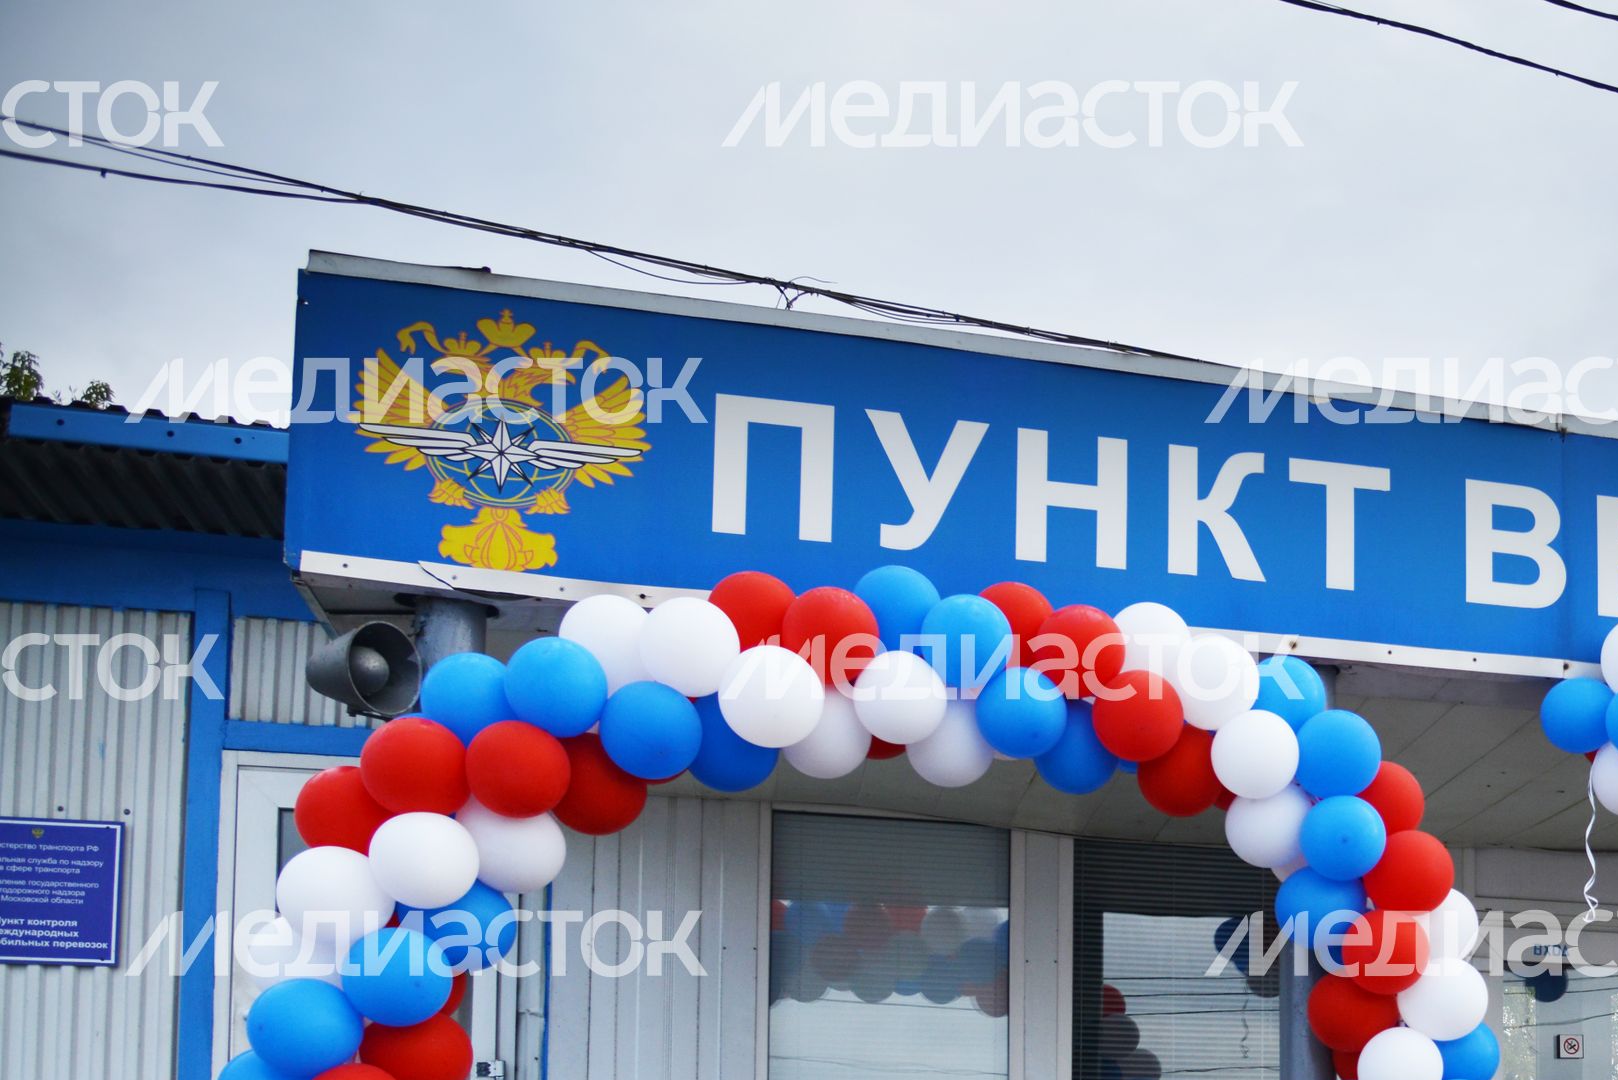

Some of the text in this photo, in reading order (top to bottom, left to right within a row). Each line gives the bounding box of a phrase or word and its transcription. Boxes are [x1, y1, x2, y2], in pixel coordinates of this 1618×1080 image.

[711, 392, 1391, 592] ПУНКТ
[0, 842, 99, 852] стерство транспорта РФ
[0, 856, 26, 864] льная
[27, 857, 58, 867] служба
[71, 859, 104, 869] надзору
[6, 865, 33, 873] сфере
[34, 865, 81, 875] транспорта
[28, 879, 99, 889] государственного
[52, 889, 86, 898] надзора
[1, 894, 84, 905] Московской области
[27, 917, 78, 928] контроля
[0, 936, 109, 950] бильных перевозок
